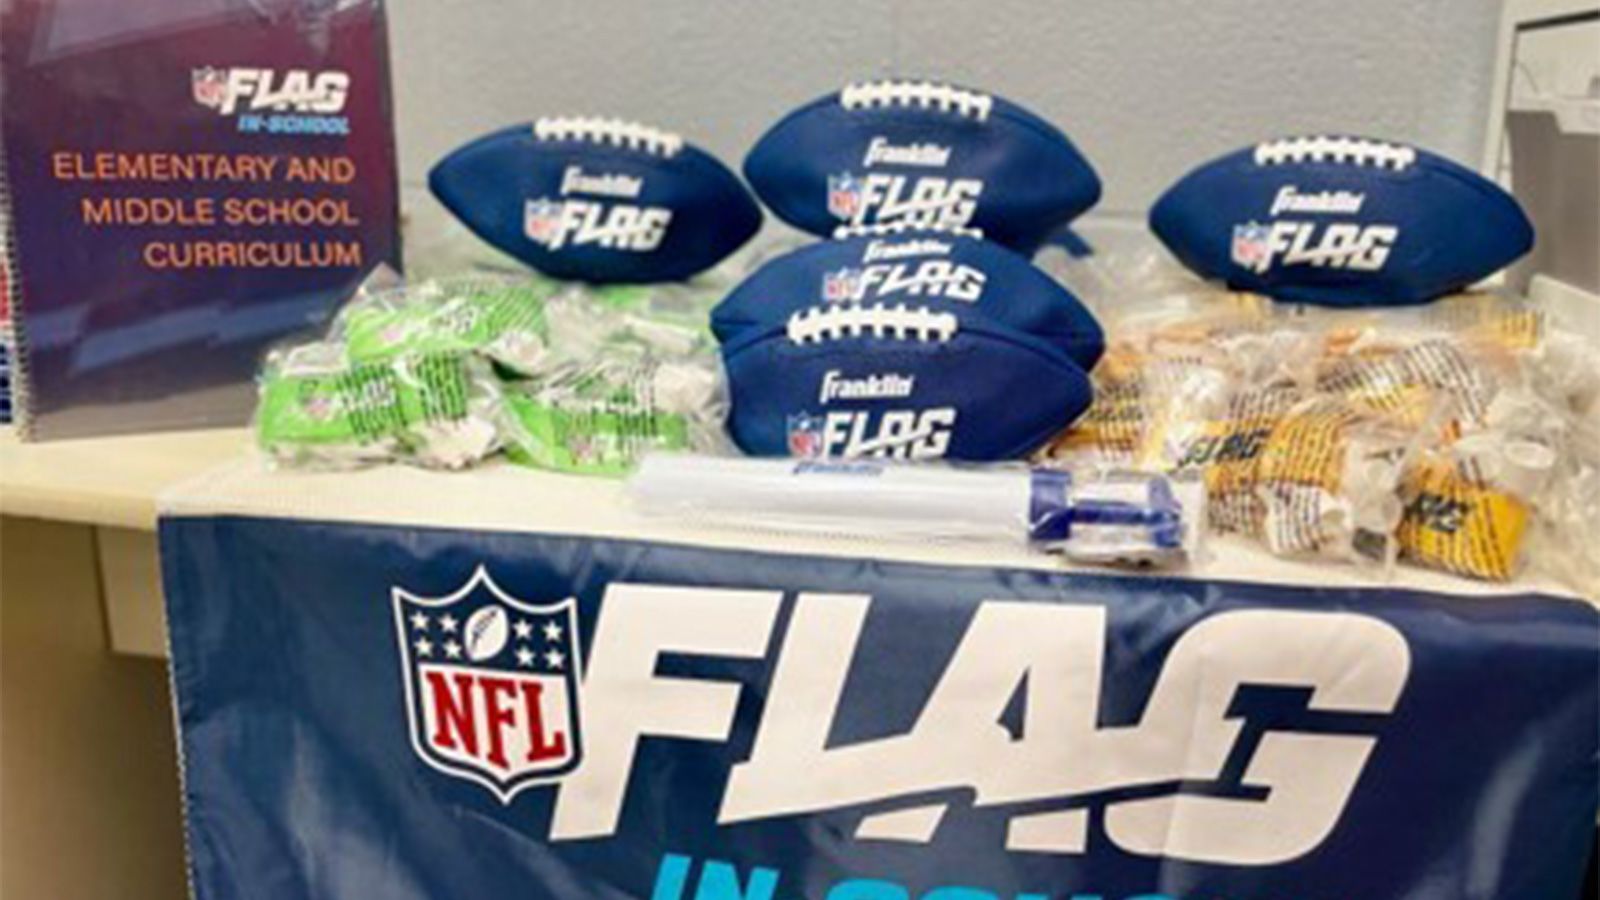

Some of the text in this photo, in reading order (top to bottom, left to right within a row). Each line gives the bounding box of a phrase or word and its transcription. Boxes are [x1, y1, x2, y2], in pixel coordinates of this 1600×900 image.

[219, 68, 350, 115] FLAG
[53, 152, 355, 184] ELEMENTARY AND
[82, 199, 359, 226] MIDDLE SCHOOL
[851, 173, 984, 227] FLAG
[548, 199, 673, 251] FLAG
[1254, 220, 1399, 275] FLAG
[143, 242, 362, 268] CURRICULUM
[850, 259, 987, 303] FLAG
[822, 407, 956, 461] FLAG
[424, 584, 1411, 867] NFL FLAG
